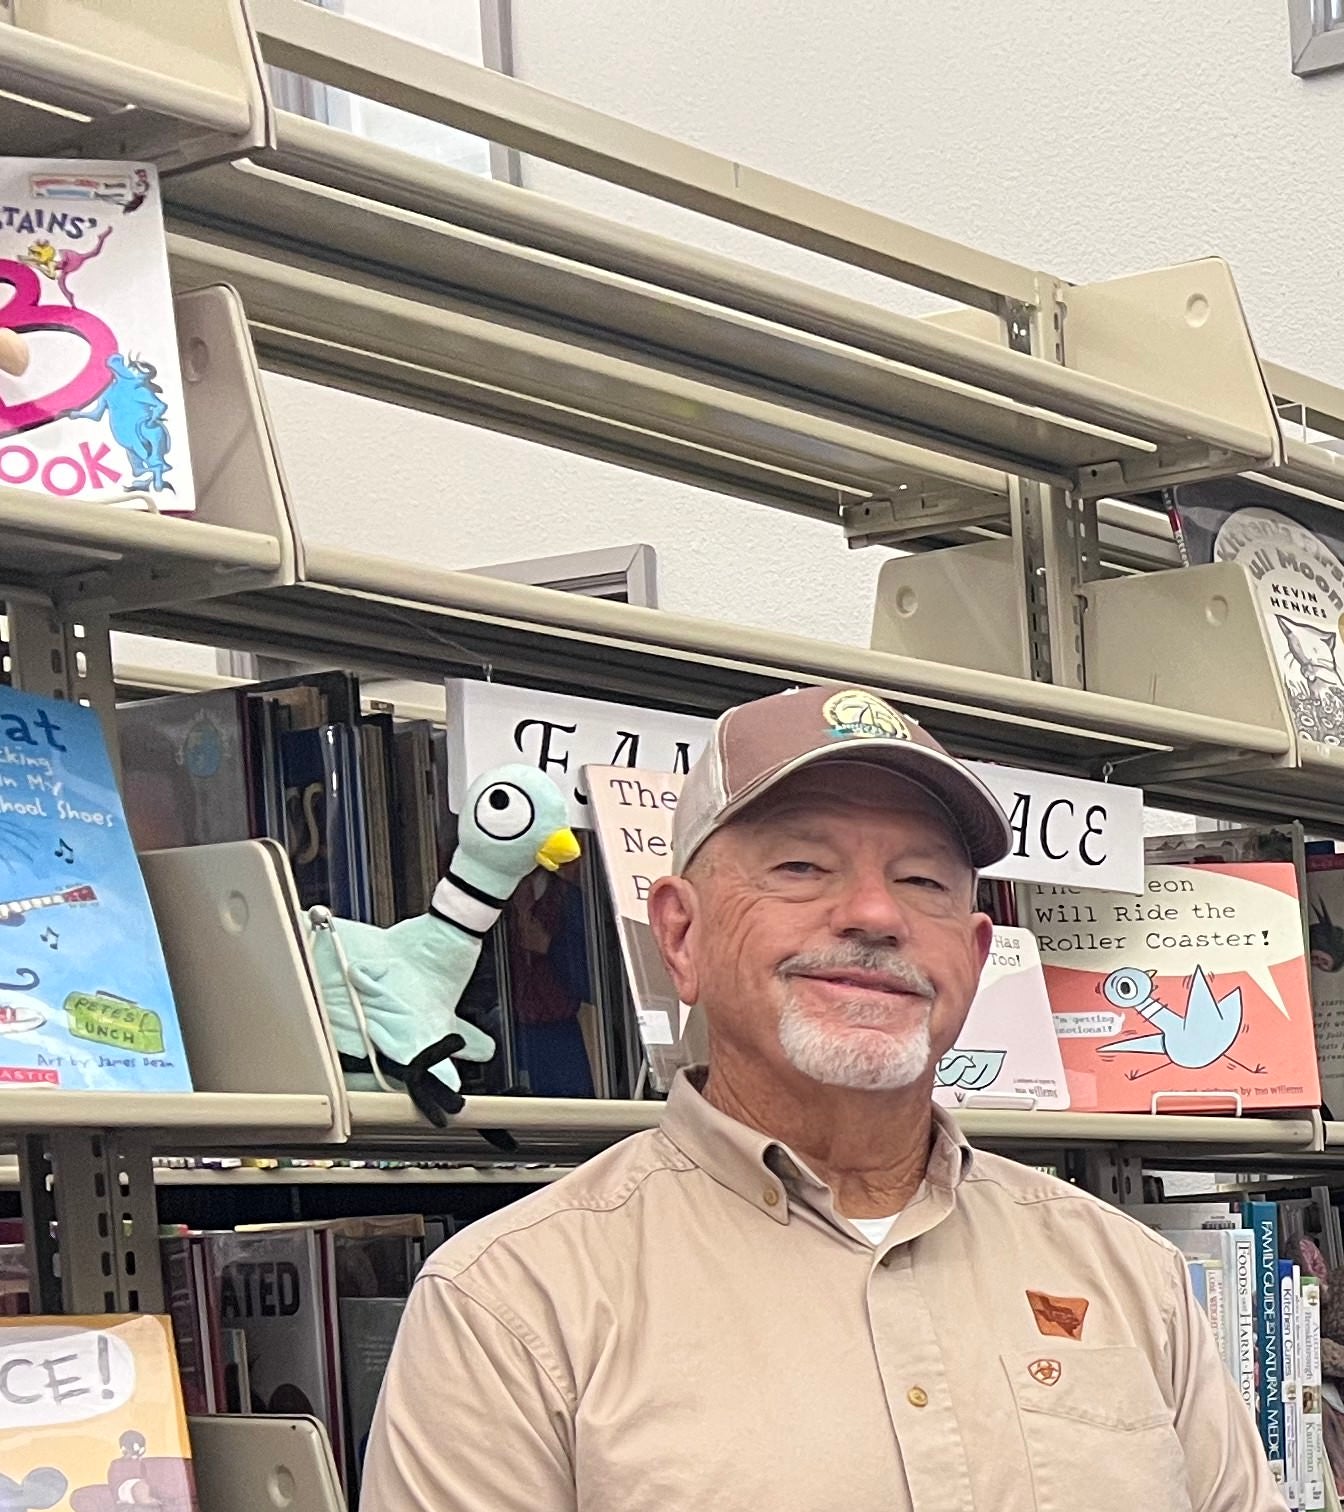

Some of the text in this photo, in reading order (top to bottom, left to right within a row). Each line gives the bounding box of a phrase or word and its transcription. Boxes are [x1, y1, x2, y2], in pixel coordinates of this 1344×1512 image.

[1271, 583, 1318, 603] KEVIN
[1270, 596, 1327, 619] HENKES
[26, 773, 64, 796] My
[57, 799, 113, 827] Shoes
[1008, 792, 1107, 866] ACE
[1035, 904, 1236, 923] Will Ride the
[1037, 930, 1270, 952] Roller Coaster!
[98, 1056, 136, 1068] James
[1237, 1242, 1249, 1296] FOODS
[1261, 1221, 1279, 1406] FAMILY GUIDE NATURAL
[1283, 1288, 1293, 1377] Kitchen Cures
